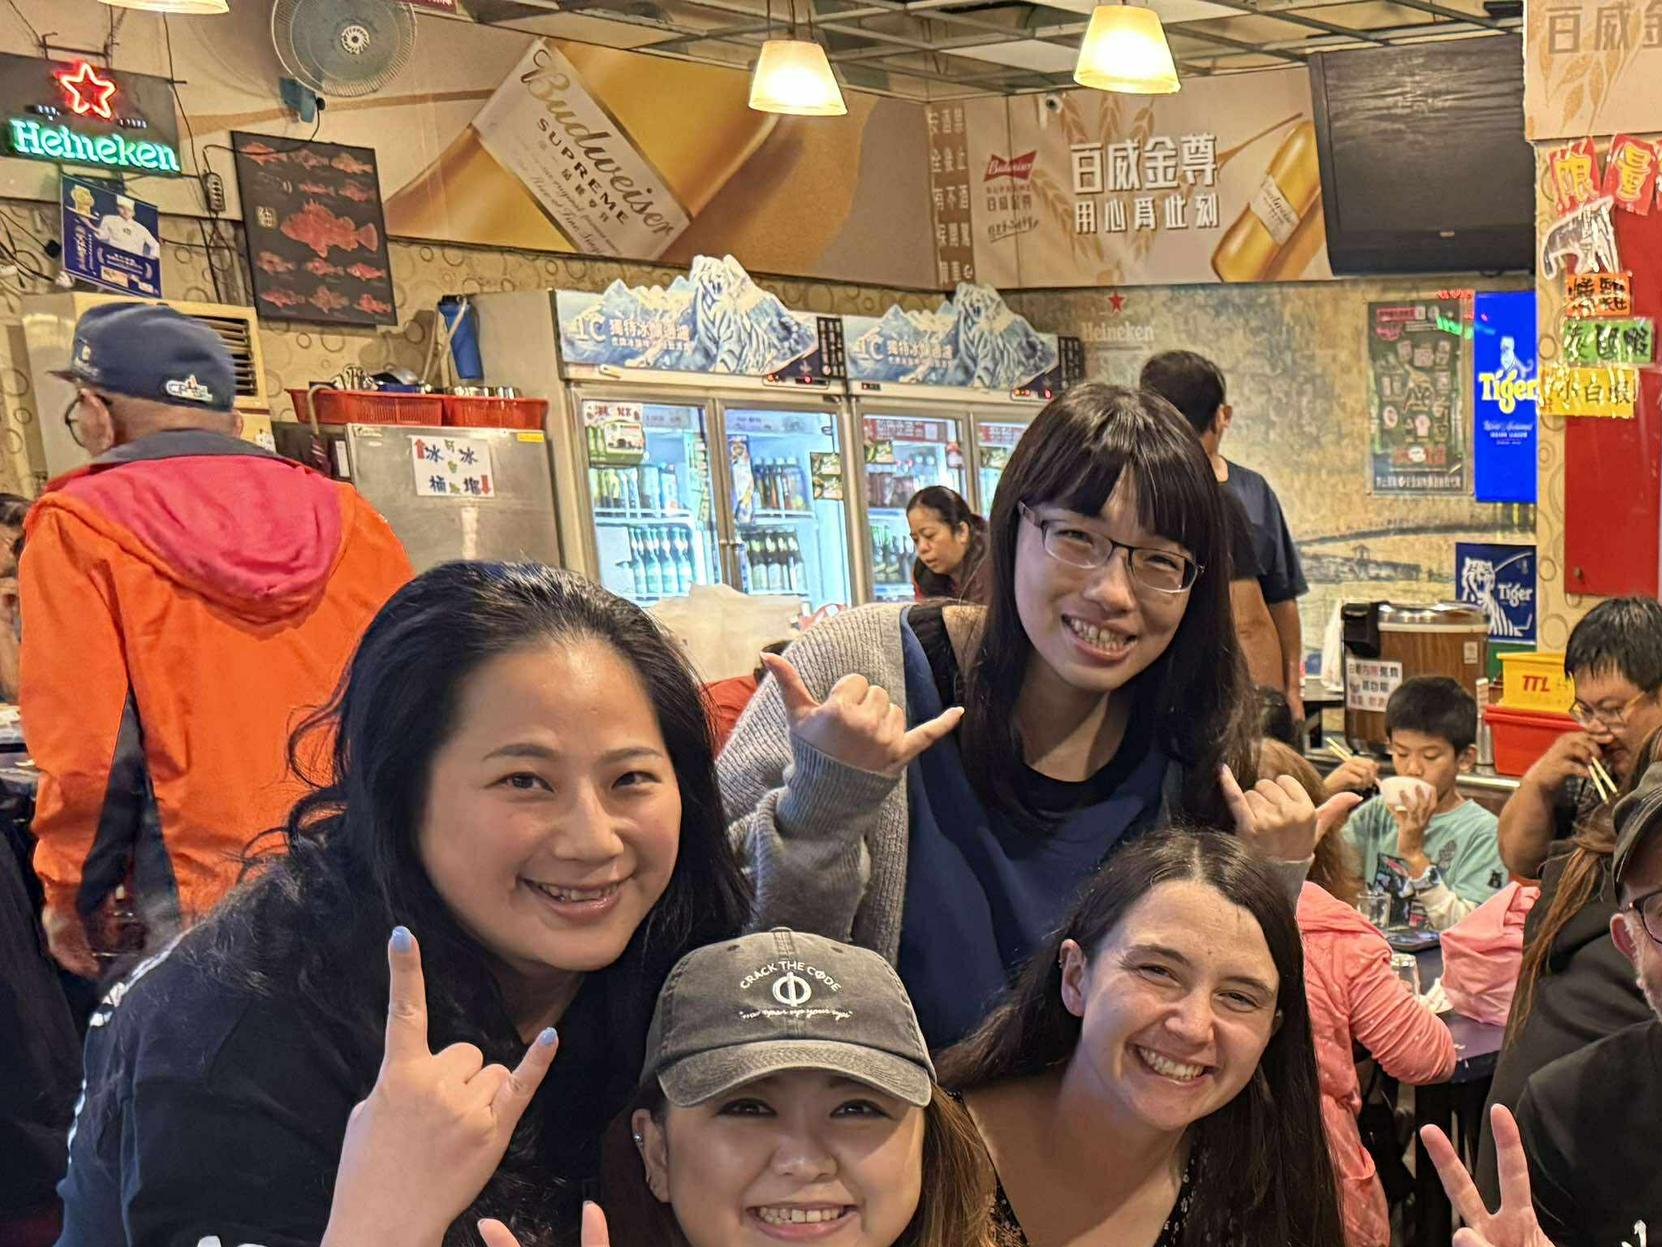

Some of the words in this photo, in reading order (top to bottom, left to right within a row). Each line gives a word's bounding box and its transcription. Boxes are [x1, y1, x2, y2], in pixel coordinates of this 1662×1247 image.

[8, 119, 182, 172] Heineken
[521, 48, 675, 236] Budweiser
[1070, 132, 1218, 195] 百威金尊
[537, 117, 630, 225] SUPREME
[1080, 321, 1155, 343] Heineken
[1479, 368, 1541, 415] Tiger
[1497, 583, 1533, 608] Tiger
[1522, 675, 1551, 693] TTL
[740, 962, 778, 989] CRACK
[778, 960, 806, 972] THE
